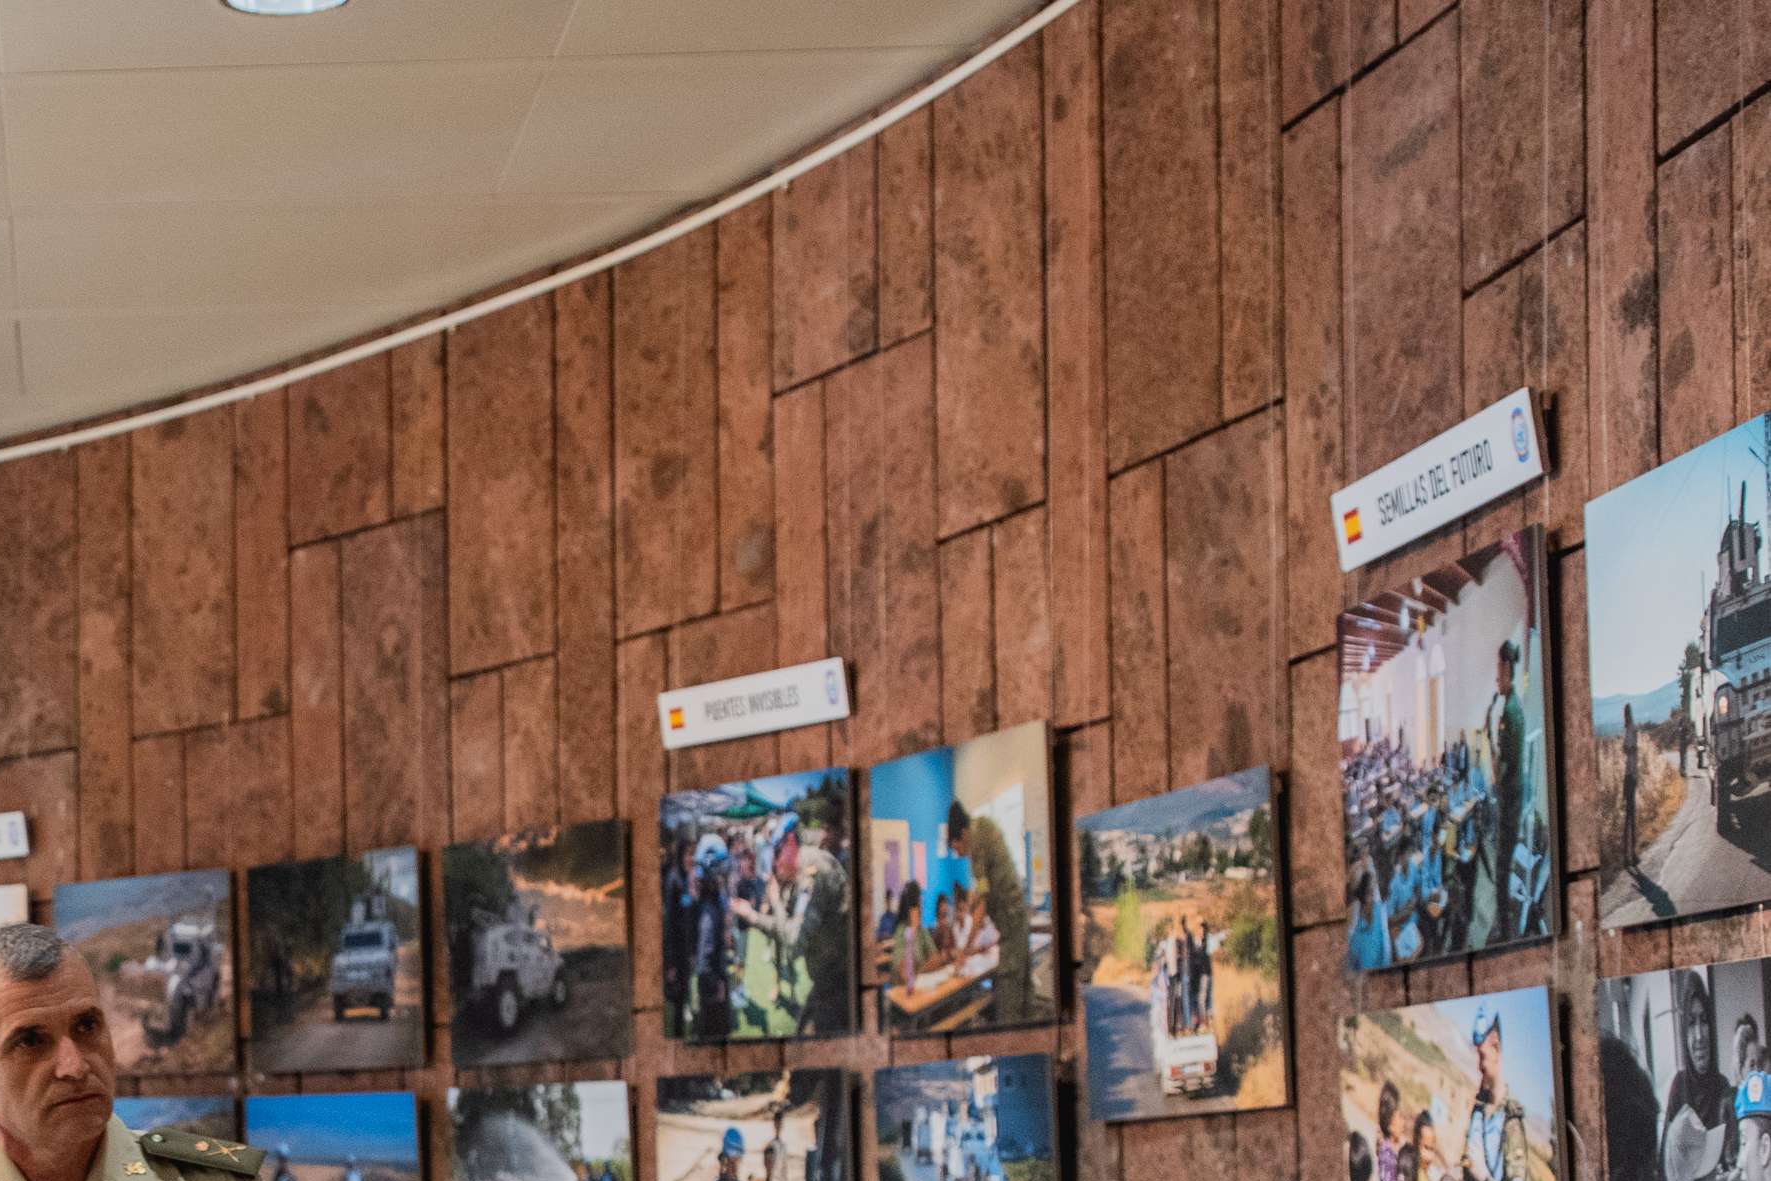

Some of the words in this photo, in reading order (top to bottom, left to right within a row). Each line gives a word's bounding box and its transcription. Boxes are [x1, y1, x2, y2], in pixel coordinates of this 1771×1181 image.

[1377, 473, 1428, 526] SEMILLAS
[1428, 464, 1450, 500] DEL
[1449, 439, 1493, 489] FUTURO
[704, 694, 747, 722] PUENTES
[747, 685, 800, 715] INVISIBLES
